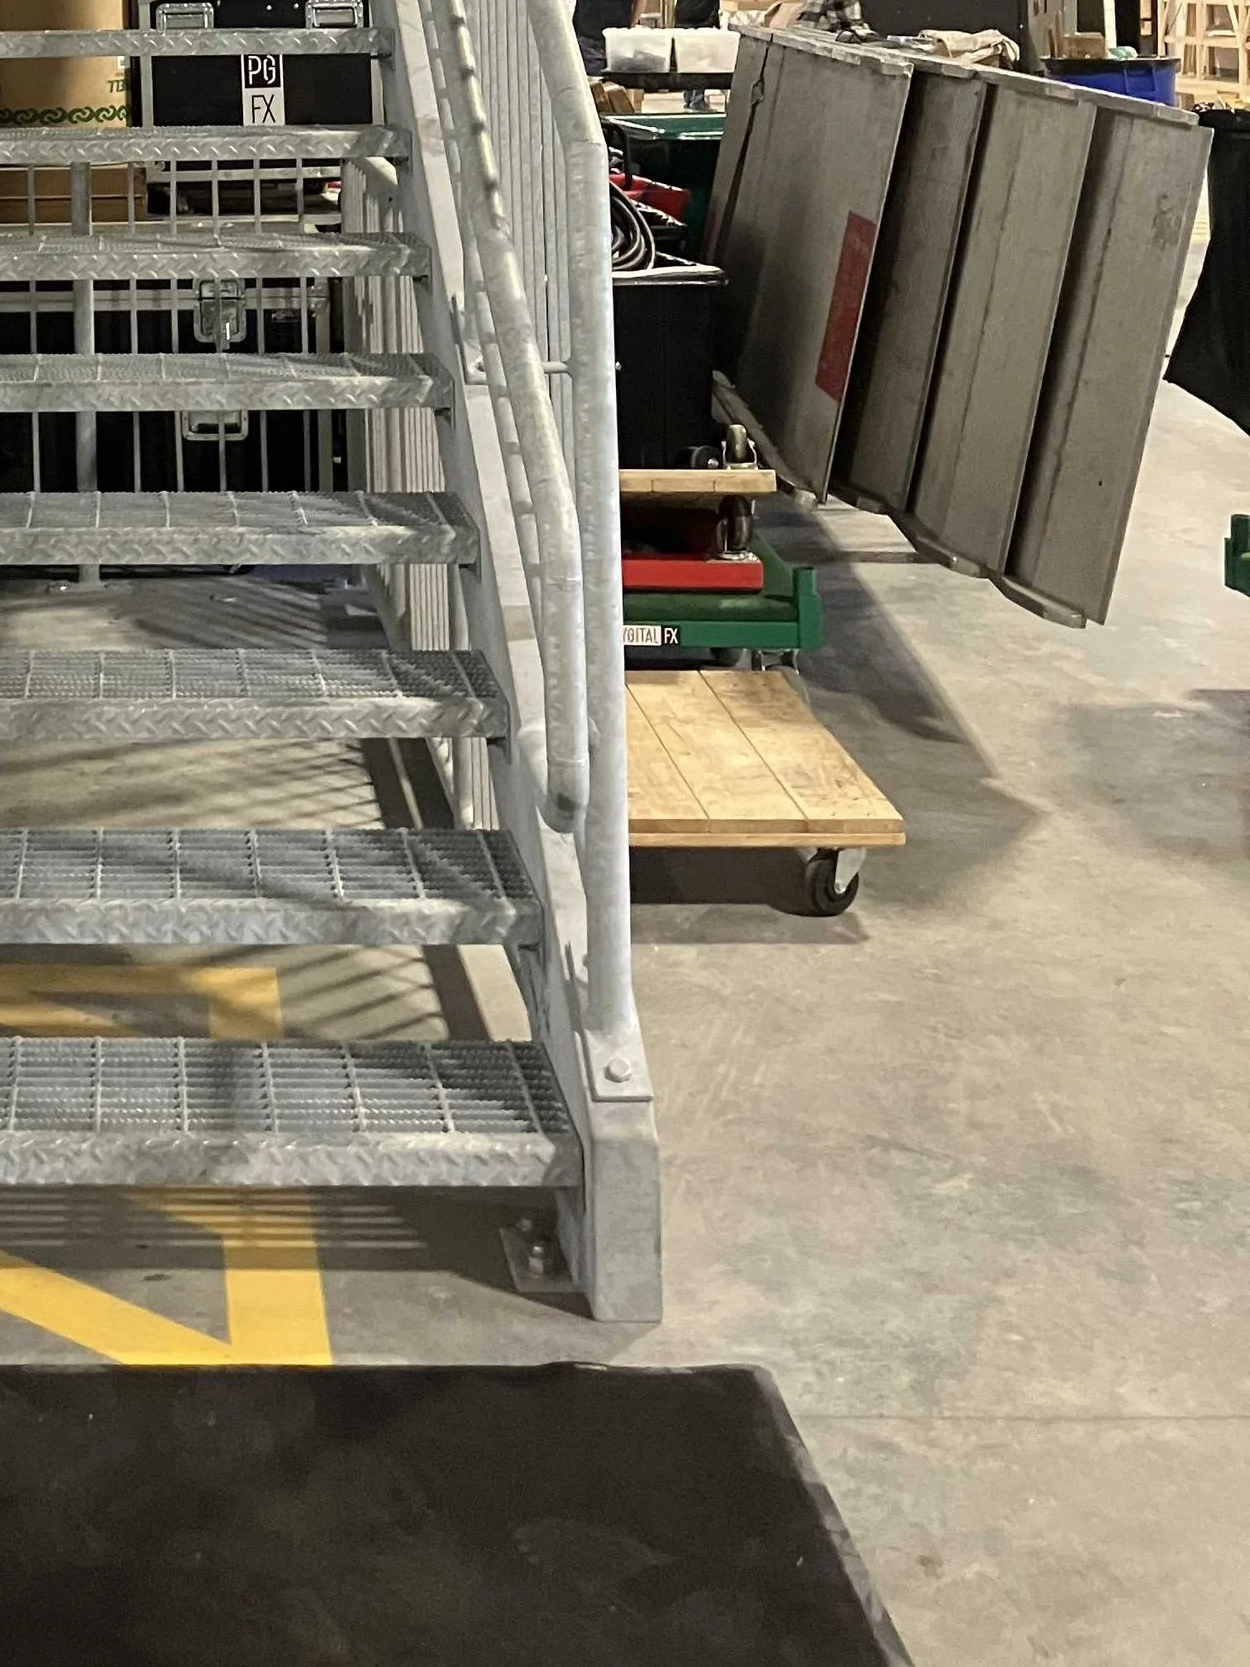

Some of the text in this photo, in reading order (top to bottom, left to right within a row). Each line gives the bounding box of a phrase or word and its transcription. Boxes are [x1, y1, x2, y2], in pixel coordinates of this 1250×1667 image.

[248, 54, 276, 85] PG
[251, 94, 276, 124] FX
[664, 627, 679, 644] FX
